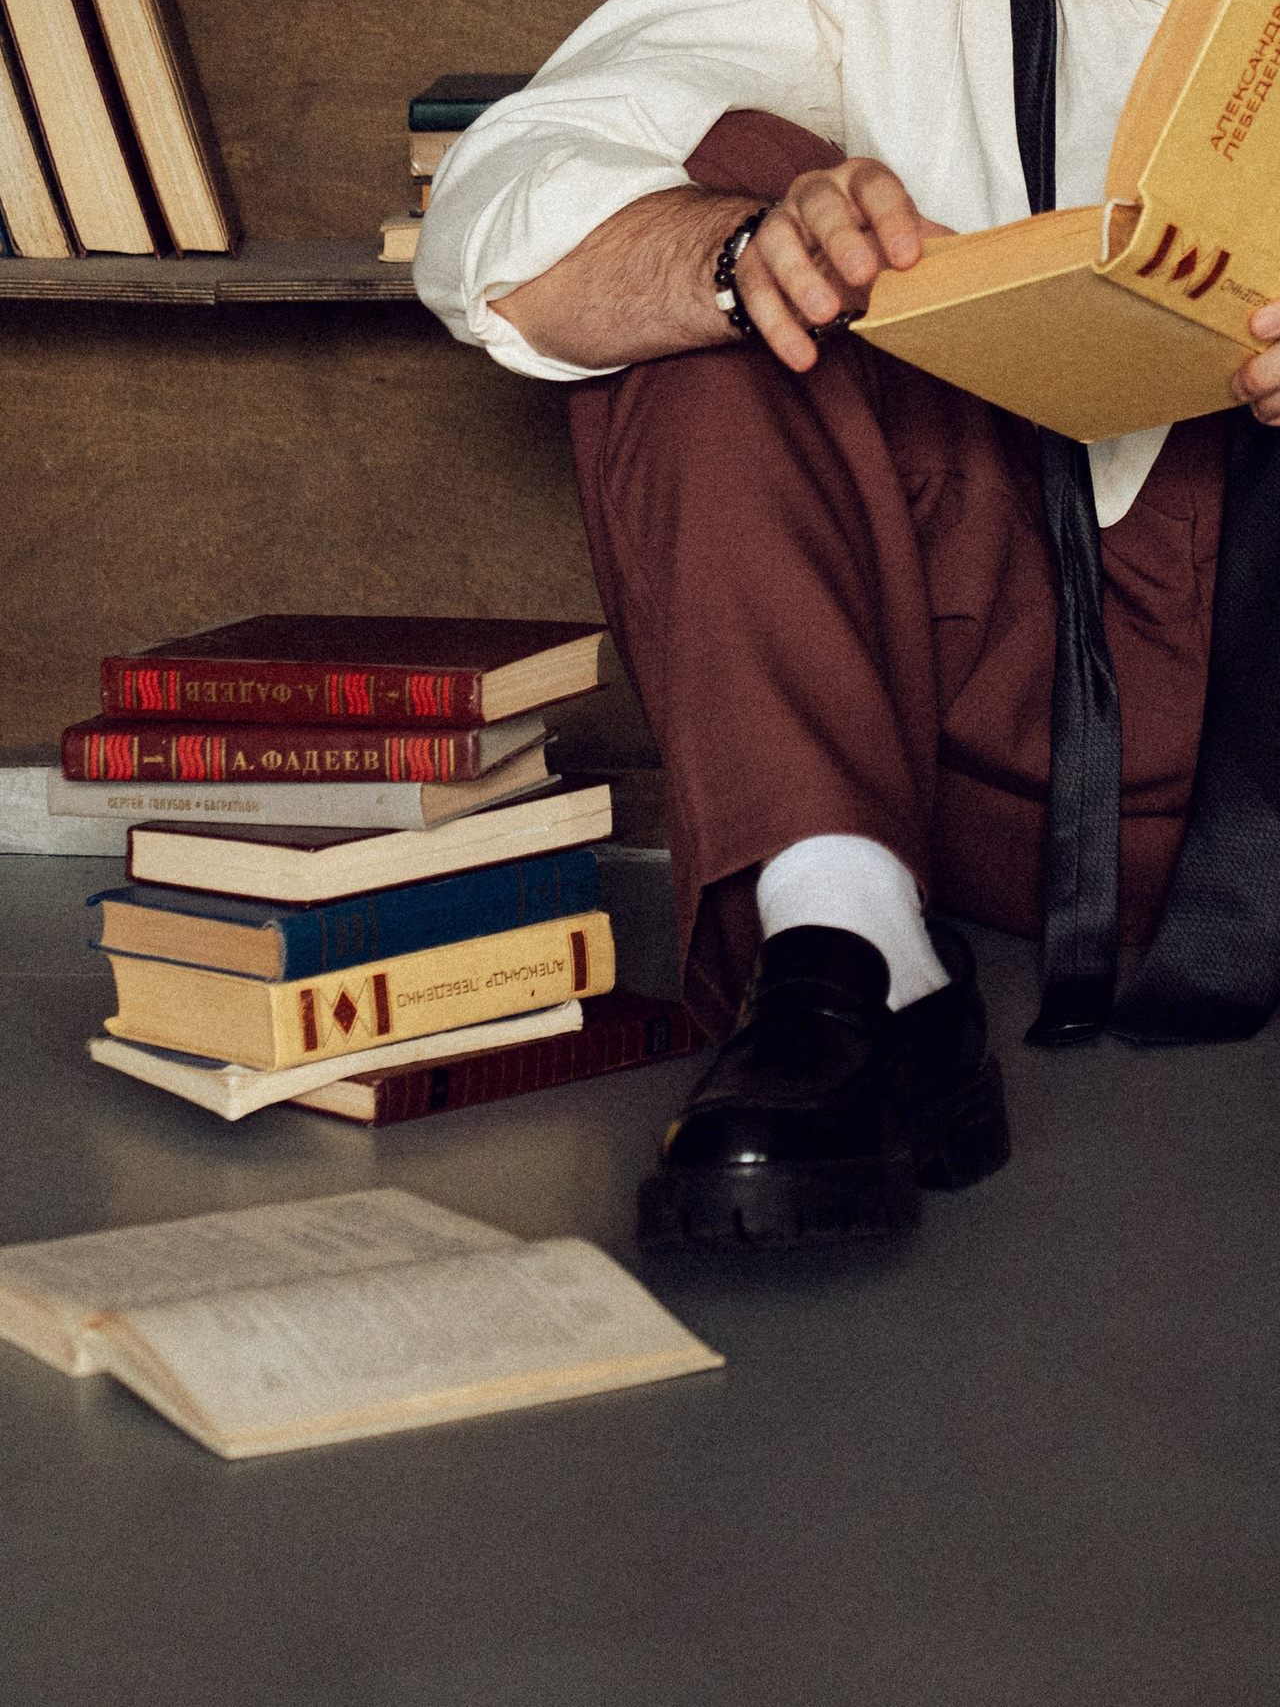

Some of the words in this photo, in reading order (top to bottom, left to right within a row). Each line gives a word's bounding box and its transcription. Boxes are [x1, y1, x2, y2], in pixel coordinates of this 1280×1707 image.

[184, 680, 292, 704] ФАДЕЕВ
[230, 750, 256, 772] А.
[261, 749, 382, 776] ФАДЕЕВ
[484, 957, 566, 990] АЛЕКСАНДР
[396, 976, 480, 1010] ЛЕБЕДЕНКО
